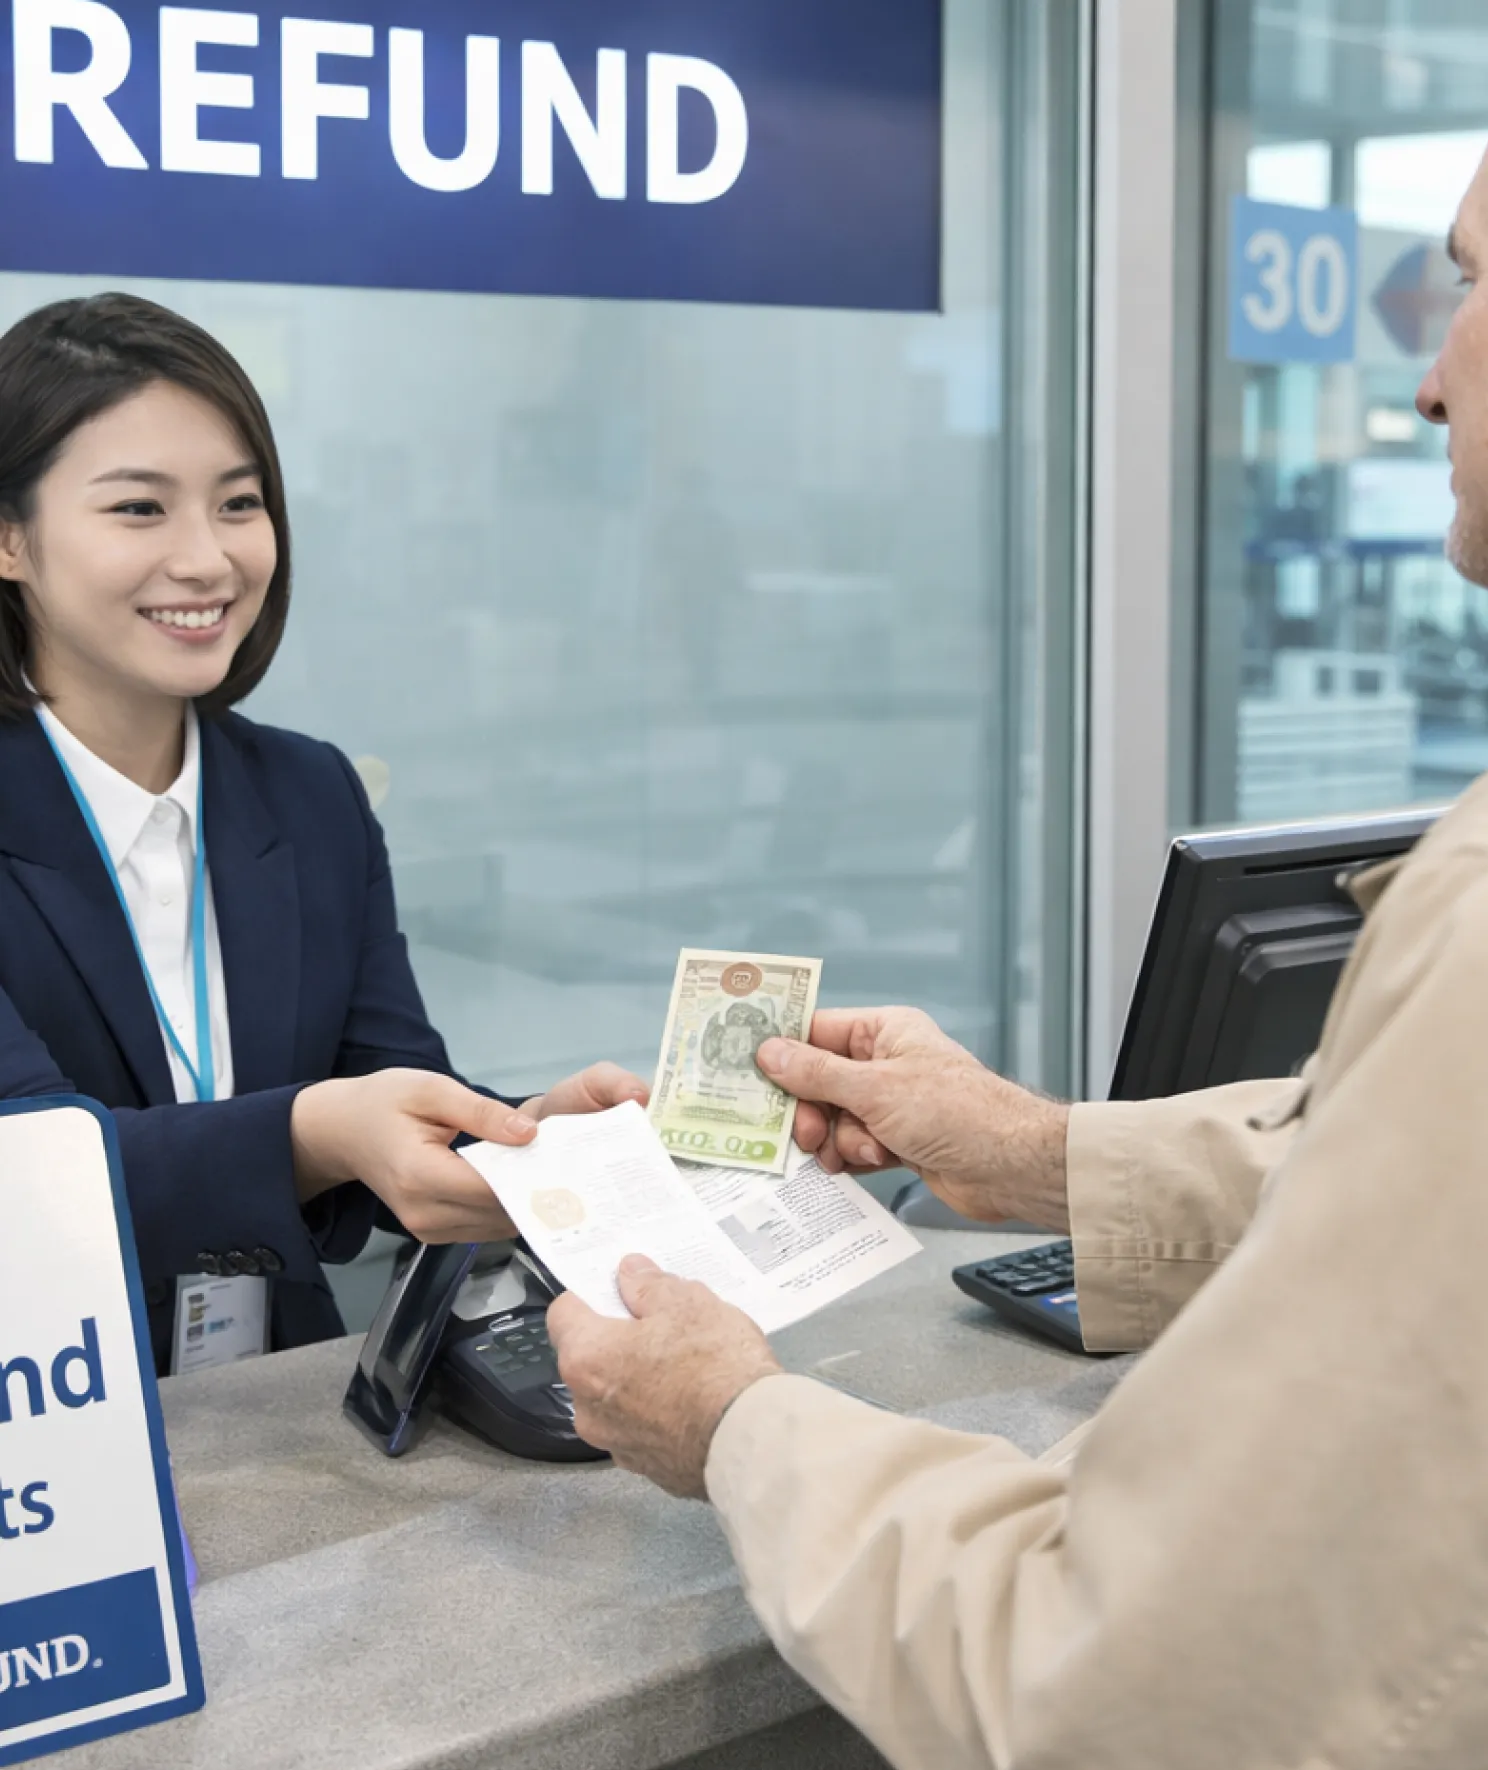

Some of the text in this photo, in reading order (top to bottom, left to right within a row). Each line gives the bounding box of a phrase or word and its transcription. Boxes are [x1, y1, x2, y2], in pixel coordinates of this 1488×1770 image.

[13, 0, 748, 204] REFUND
[1243, 229, 1347, 338] 30
[0, 1317, 107, 1423] nd
